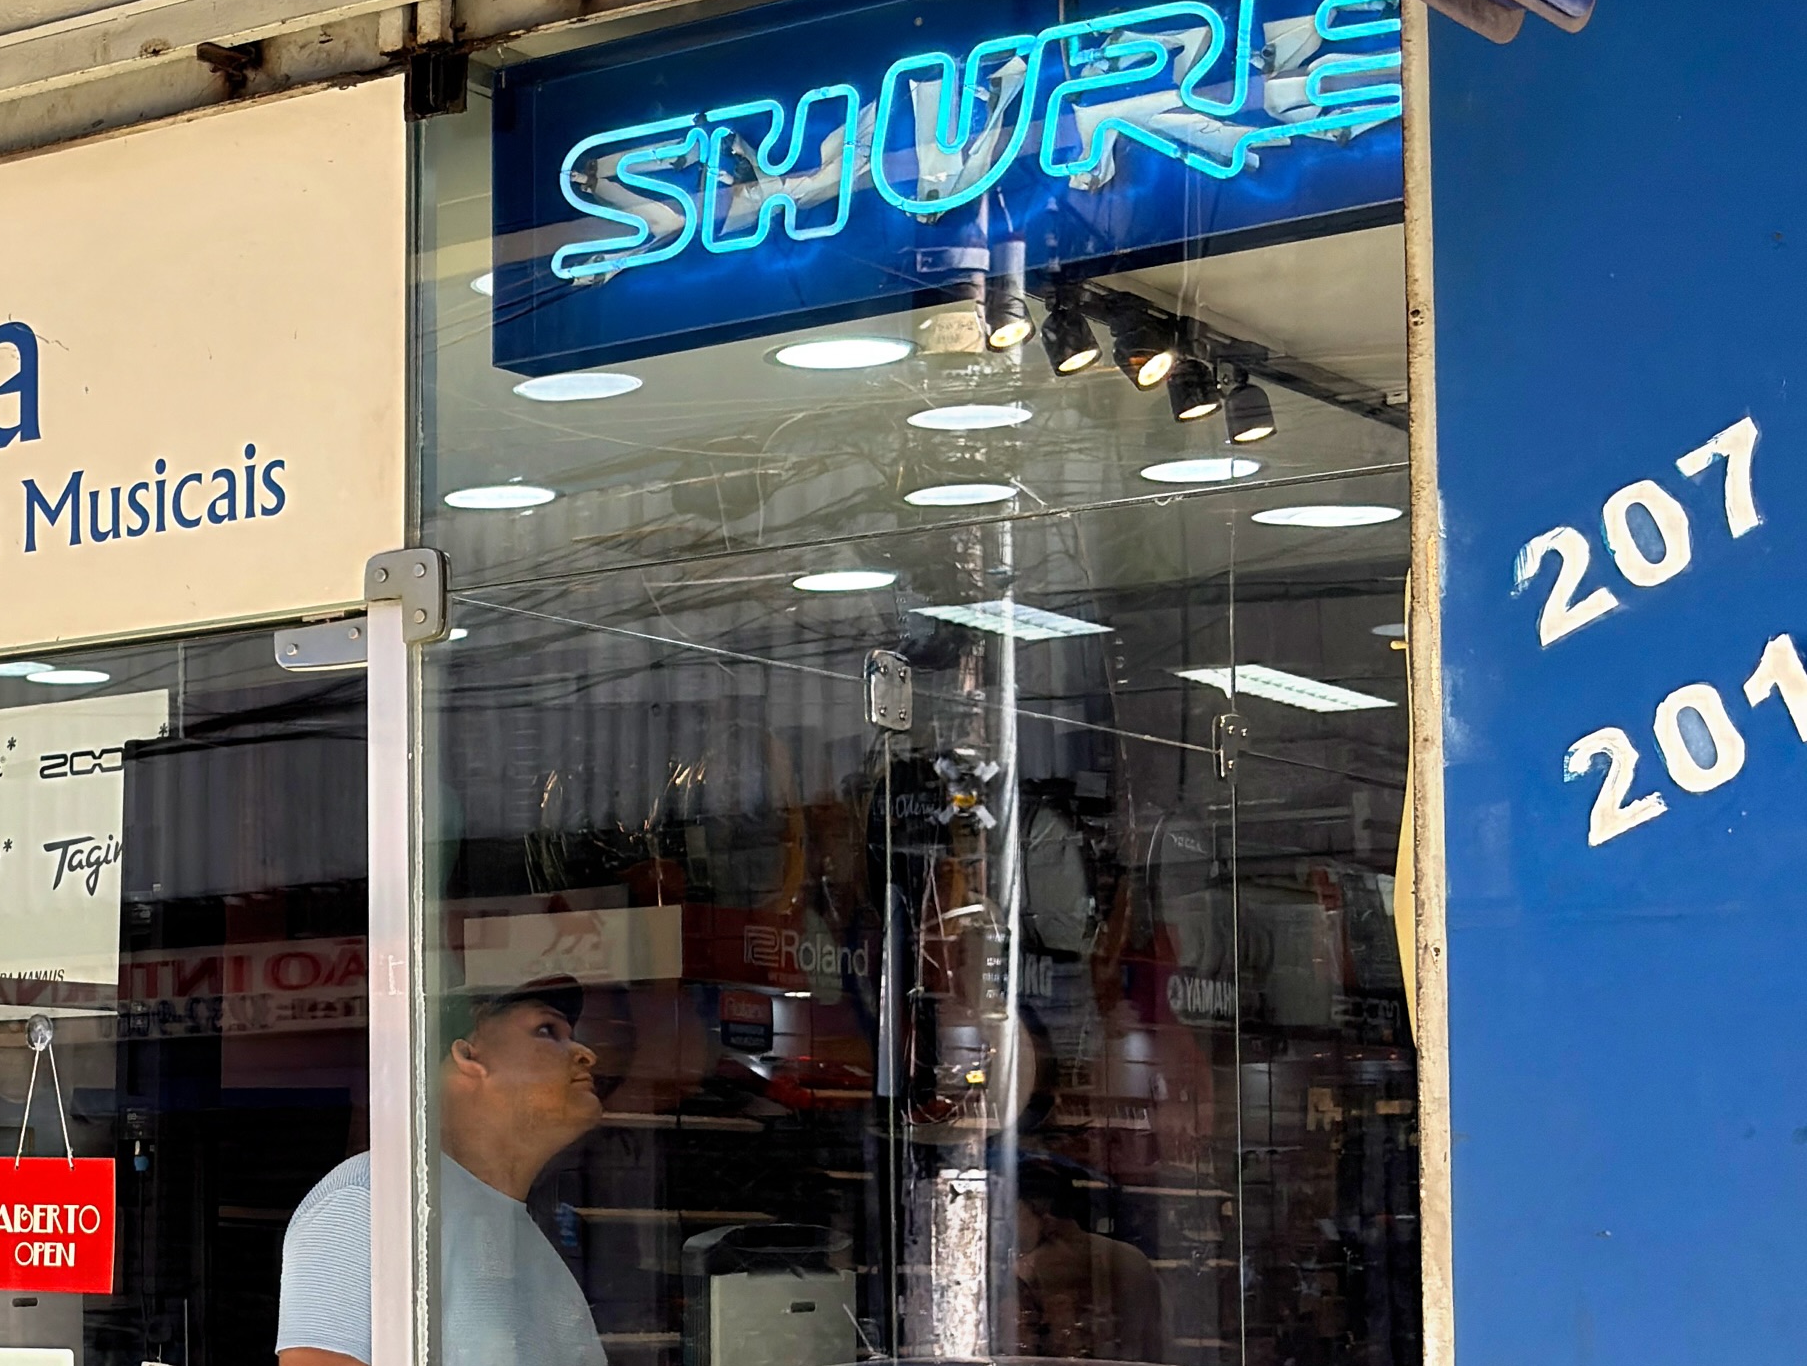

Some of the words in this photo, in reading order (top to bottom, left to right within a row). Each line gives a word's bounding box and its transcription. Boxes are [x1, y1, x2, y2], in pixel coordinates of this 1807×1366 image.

[20, 442, 287, 553] Musicais
[1511, 416, 1760, 647] 207
[40, 747, 124, 780] ZOO
[1563, 633, 1807, 847] 201
[781, 928, 869, 977] Roland
[1184, 976, 1235, 1016] YAMAH
[14, 1241, 76, 1268] OPEN
